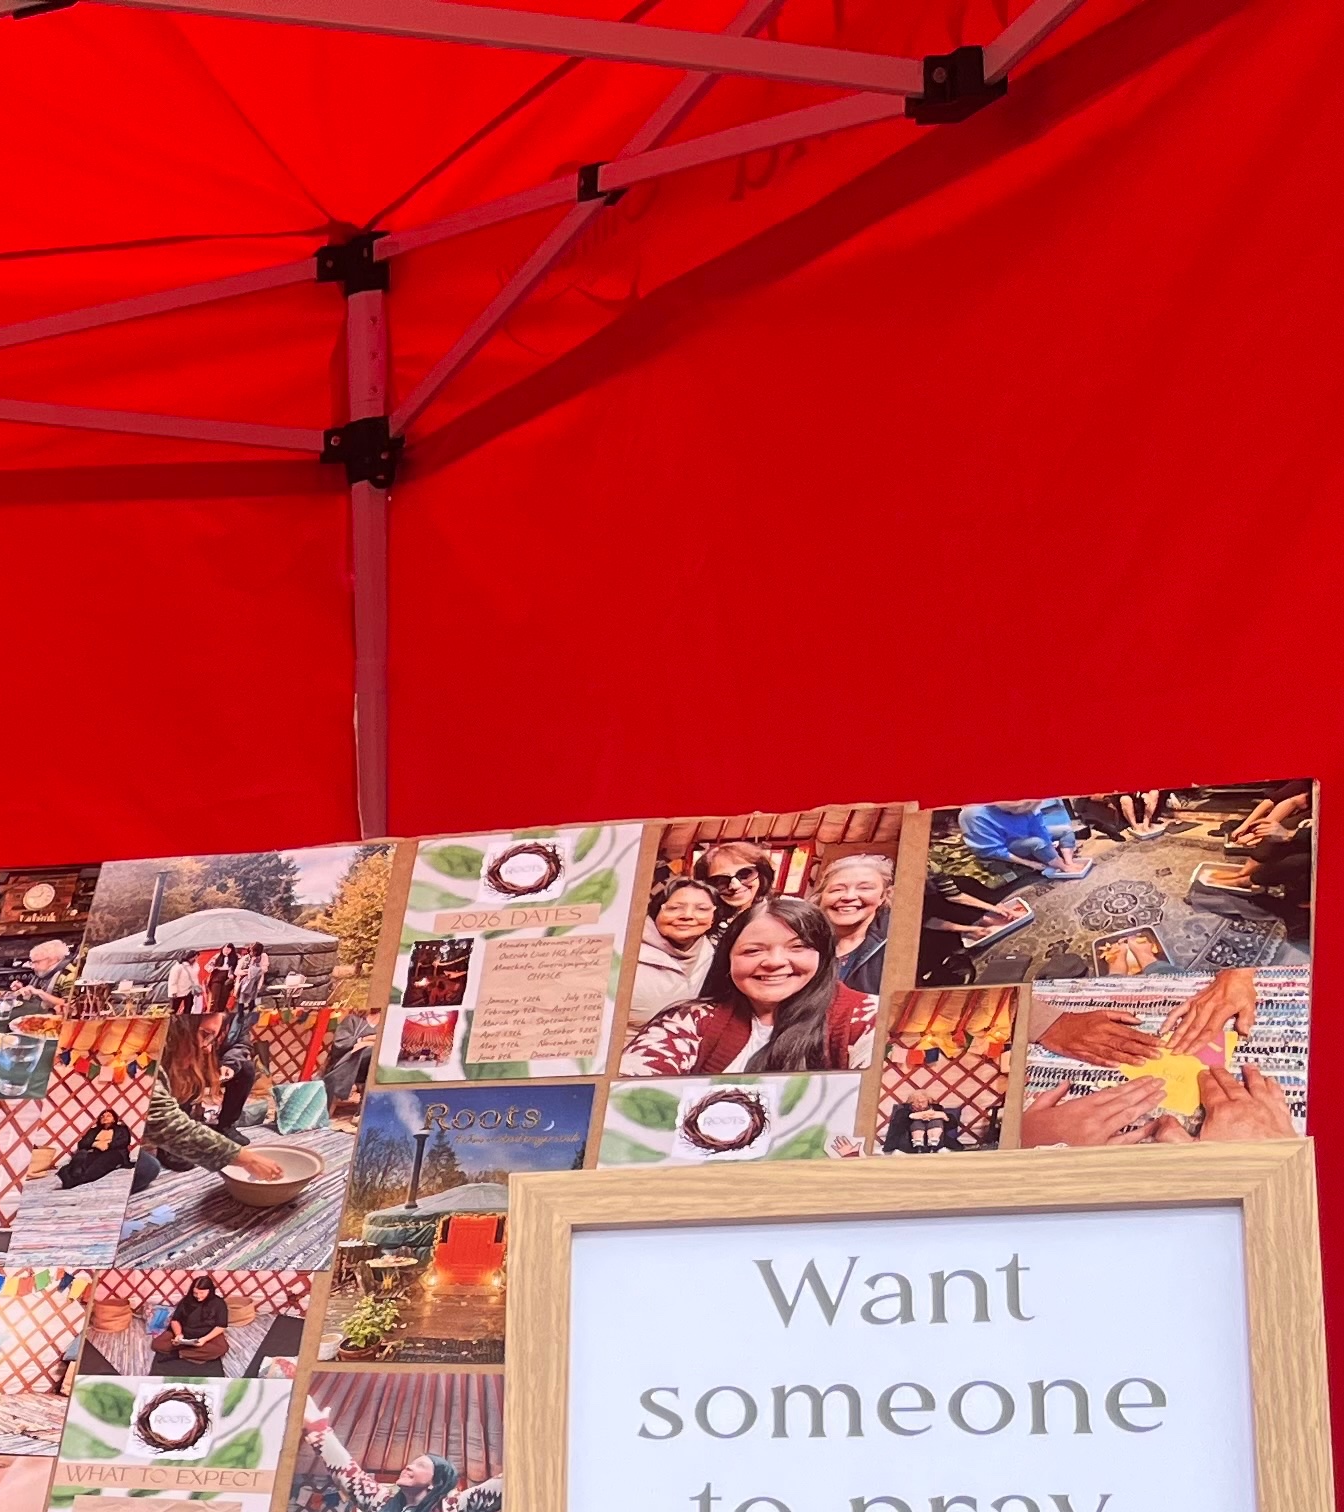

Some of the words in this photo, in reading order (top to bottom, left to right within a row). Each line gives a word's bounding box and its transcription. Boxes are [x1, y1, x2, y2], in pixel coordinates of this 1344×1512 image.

[451, 912, 500, 930] 2026
[511, 907, 582, 926] DATES
[483, 1008, 519, 1016] February
[480, 1019, 508, 1027] March
[536, 1016, 577, 1025] September
[478, 1042, 497, 1050] May
[537, 1039, 578, 1047] November
[530, 1050, 570, 1059] December
[421, 1103, 542, 1132] Roots
[703, 1115, 746, 1127] ROOTS
[753, 1254, 1035, 1328] Want
[638, 1378, 1167, 1440] someone
[154, 1414, 192, 1425] ROOTS
[67, 1465, 127, 1483] WHAT
[140, 1467, 167, 1484] TO
[176, 1469, 263, 1488] EXPECT
